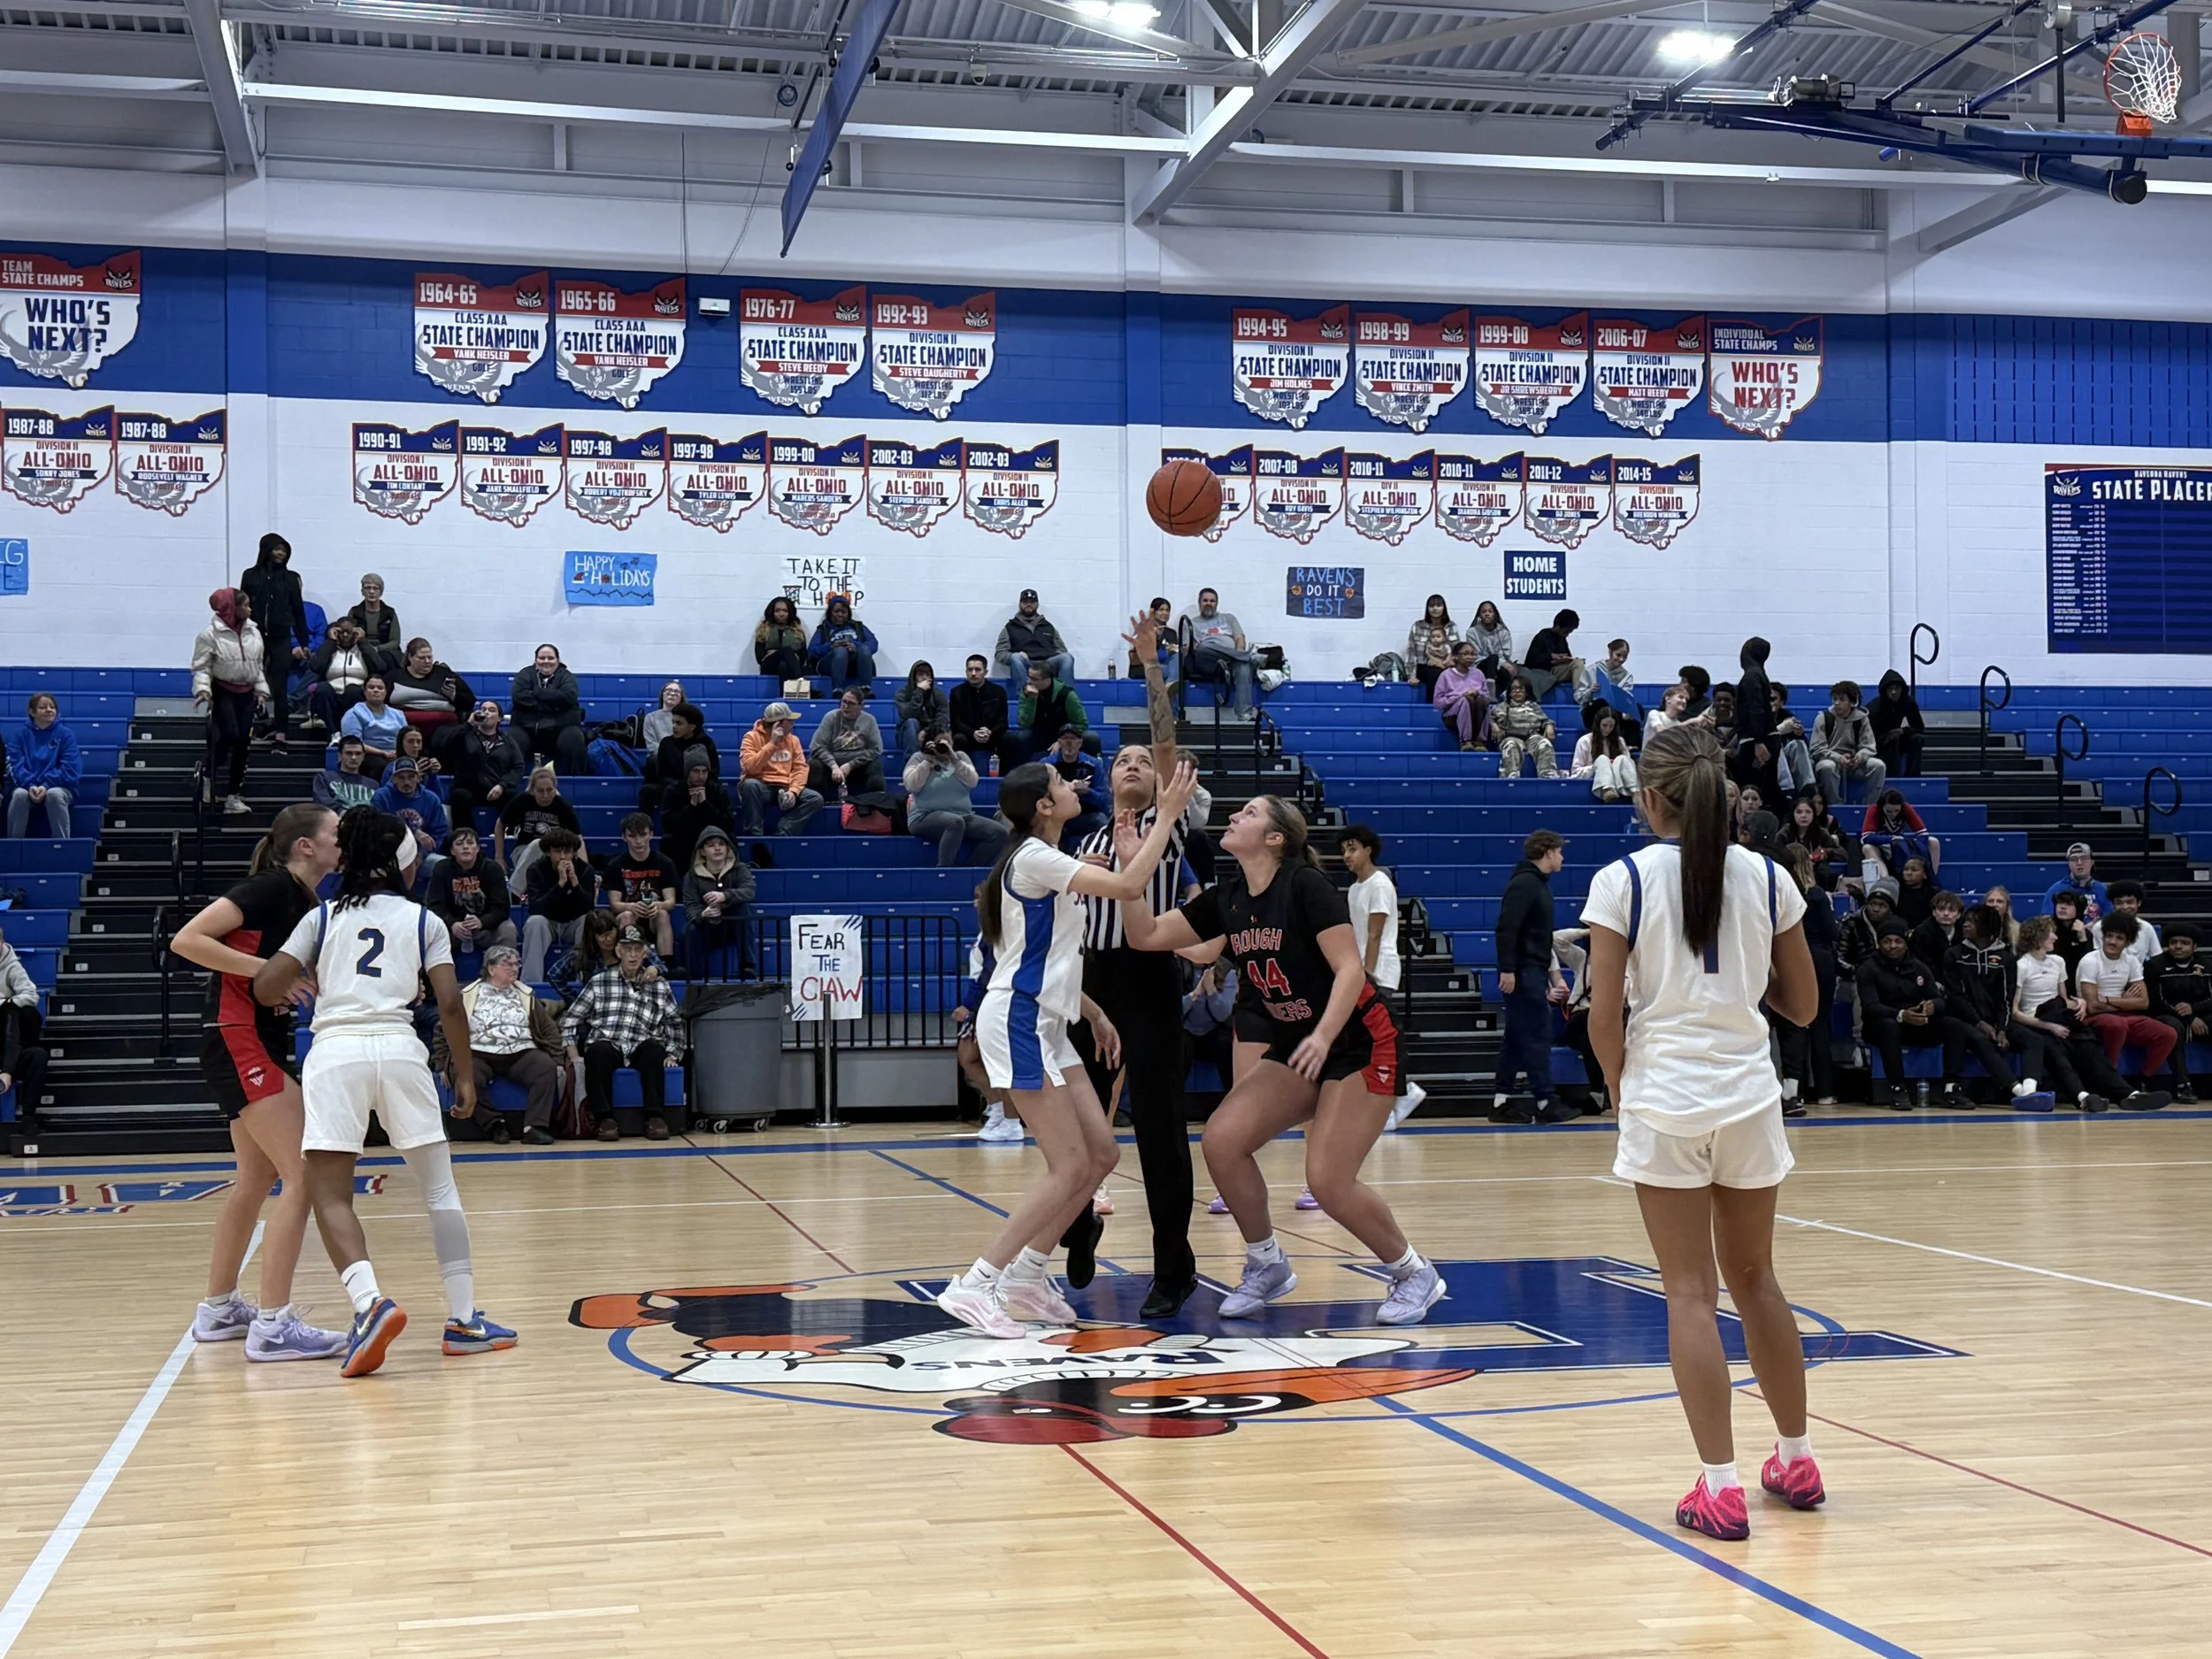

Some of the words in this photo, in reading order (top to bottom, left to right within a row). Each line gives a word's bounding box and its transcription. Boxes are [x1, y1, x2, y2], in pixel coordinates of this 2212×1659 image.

[3, 260, 33, 273] TEAM
[3, 273, 34, 285] STATE
[38, 274, 83, 287] CHAMPS
[419, 283, 477, 305] 1964-65
[561, 290, 616, 311] 1965-66
[25, 298, 111, 326] WHO'S
[745, 298, 795, 319] 1976-77
[877, 303, 928, 325] 1992-93
[455, 311, 484, 325] CLASS
[487, 312, 508, 326] AAA
[595, 319, 623, 332] CLASS
[626, 319, 646, 332] AAA
[778, 326, 806, 339] CLASS
[808, 328, 827, 339] AAA
[1238, 318, 1287, 337] 1994-95
[1360, 321, 1409, 341] 1998-99
[1479, 325, 1529, 344] 1999-00
[1715, 328, 1765, 340] INDIVIDUAL
[28, 326, 107, 353] NEXT?
[423, 326, 465, 347] STATE
[467, 327, 539, 349] CHAMPION
[564, 333, 605, 353] STATE
[608, 334, 677, 355] CHAMPION
[910, 333, 949, 343] DIVISION
[951, 334, 957, 344] II
[1598, 328, 1647, 347] 2006-07
[1714, 340, 1740, 350] STATE
[1741, 341, 1778, 350] CHAMPS
[477, 349, 509, 360] HEISLER
[749, 339, 786, 358] STATE
[789, 342, 857, 362] CHAMPION
[879, 344, 917, 365] STATE
[920, 347, 987, 367] CHAMPION
[1268, 344, 1306, 355] DIVISION
[1308, 345, 1313, 356] II
[1390, 349, 1427, 358] DIVISION
[1428, 349, 1434, 360] II
[1509, 351, 1546, 363] DIVISION
[1547, 352, 1553, 363] II
[617, 356, 648, 366] HEISLER
[779, 363, 802, 372] STEVE
[803, 364, 827, 373] REEDY
[1240, 357, 1275, 375] STATE
[1278, 358, 1341, 378] CHAMPION
[1627, 355, 1663, 365] DIVISION
[1664, 356, 1671, 365] II
[924, 369, 968, 378] DAUGHERTY
[1363, 360, 1398, 380] STATE
[1401, 362, 1462, 381] CHAMPION
[1483, 364, 1517, 382] STATE
[1517, 365, 1580, 384] CHAMPION
[1601, 366, 1634, 386] STATE
[1637, 368, 1697, 387] CHAMPION
[1732, 362, 1798, 384] WHO'S
[1734, 388, 1795, 409] NEXT?
[8, 418, 54, 435] 1987-88
[121, 421, 166, 438] 1987-88
[359, 433, 402, 449] 1990-91
[466, 436, 506, 452] 1991-92
[571, 439, 612, 456] 1997-98
[672, 443, 714, 459] 1997-98
[773, 446, 815, 463] 1999-00
[872, 449, 913, 465] 2002-03
[969, 451, 1010, 467] 2002-03
[23, 451, 91, 469] ALL-OHIO
[136, 455, 204, 472] ALL-OHIO
[1259, 459, 1298, 473] 2007-08
[373, 465, 438, 480] ALL-OHIO
[480, 468, 544, 484] ALL-OHIO
[1350, 461, 1384, 476] 2010-11
[1440, 463, 1473, 478] 2010-11
[1530, 465, 1562, 480] 2011-12
[1618, 466, 1651, 480] 2014-15
[585, 471, 647, 488] ALL-OHIO
[687, 474, 748, 490] ALL-OHIO
[787, 478, 847, 494] ALL-OHIO
[885, 480, 944, 496] ALL-OHIO
[982, 482, 1040, 498] ALL-OHIO
[1271, 489, 1326, 503] ALL-OHIO
[2093, 481, 2144, 500] STATE
[1363, 491, 1417, 505] ALL-OHIO
[1453, 493, 1506, 507] ALL-OHIO
[1541, 495, 1594, 509] ALL-OHIO
[1631, 495, 1683, 510] ALL-OHIO
[575, 555, 615, 572] HAPPY
[787, 558, 837, 573] TAKE
[842, 558, 860, 574] IT
[1513, 557, 1556, 572] HOME
[797, 576, 819, 591] TO
[824, 576, 852, 592] THE
[1296, 567, 1355, 587] RAVENS
[1307, 585, 1322, 596] DO
[1328, 585, 1340, 596] IT
[1507, 578, 1564, 594] STUDENTS
[1303, 598, 1344, 616] BEST
[799, 924, 844, 949] FEAR
[1231, 928, 1282, 956] ROUGH
[357, 928, 385, 978] 2
[812, 955, 840, 972] THE
[1248, 958, 1291, 997] 44
[911, 1351, 1225, 1371] RAVENS
